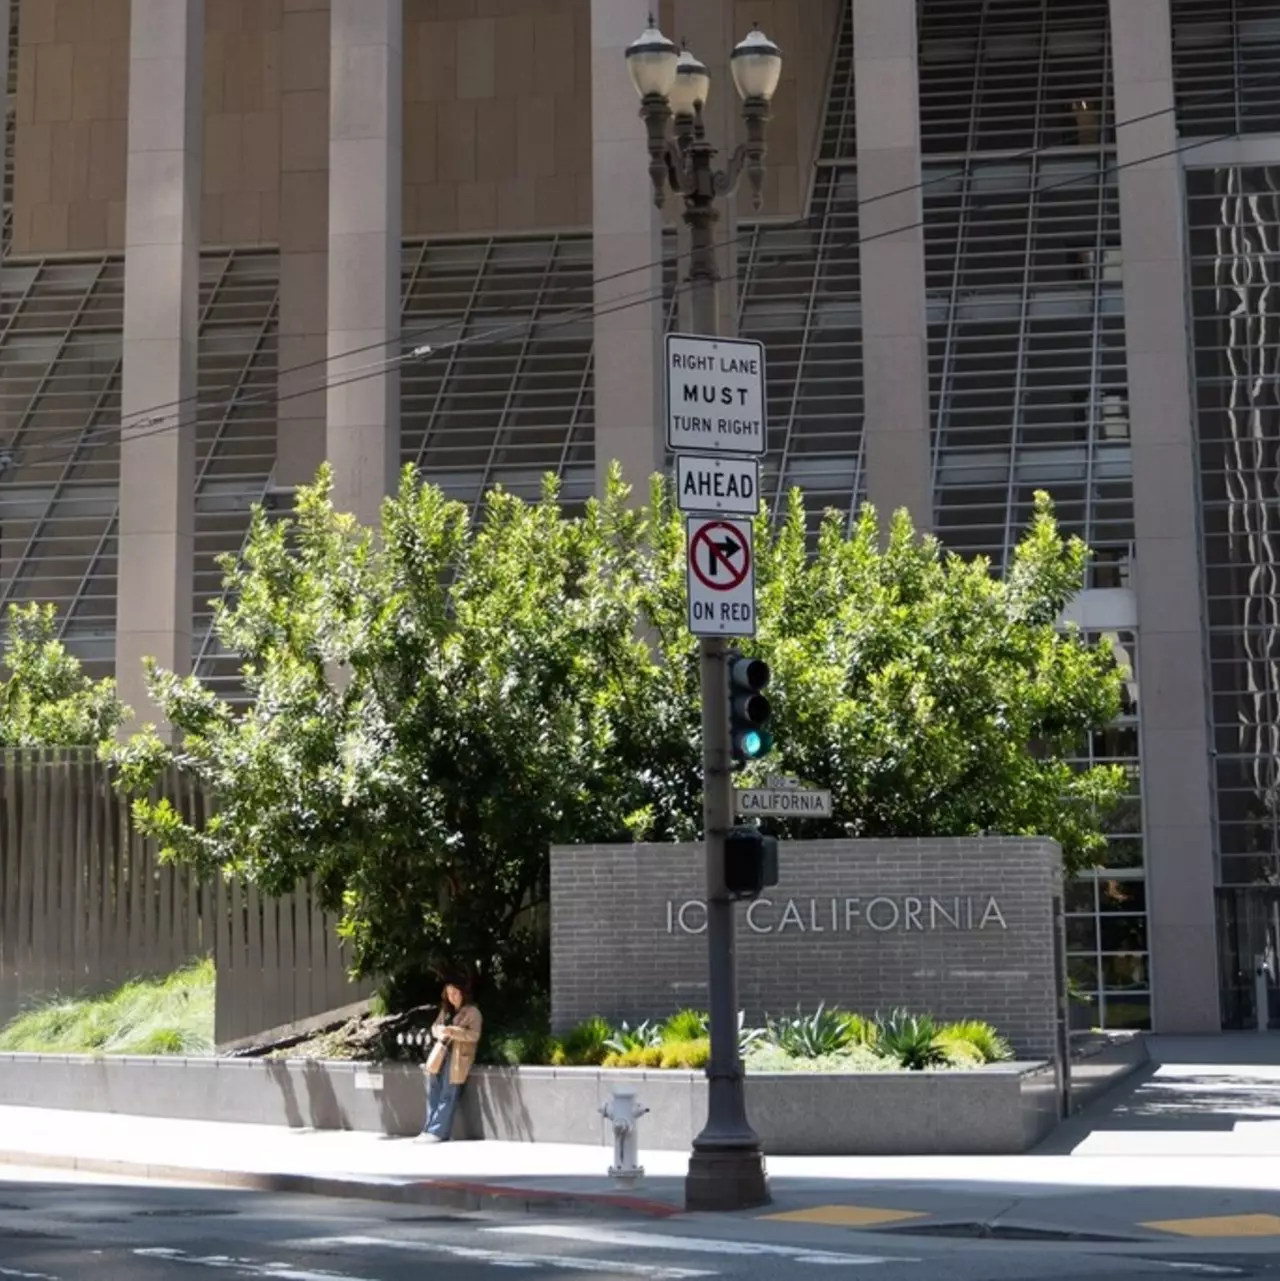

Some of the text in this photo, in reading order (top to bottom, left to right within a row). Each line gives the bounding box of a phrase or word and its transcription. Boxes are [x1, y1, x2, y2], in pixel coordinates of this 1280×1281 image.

[672, 353, 758, 375] RIGHT LANE
[683, 384, 748, 405] MUST
[672, 415, 760, 435] TURN RIGHT
[683, 471, 753, 498] AHEAD
[693, 602, 750, 621] ON RED
[742, 793, 824, 810] CALIFORNIA
[745, 895, 1008, 934] CALIFORNIA
